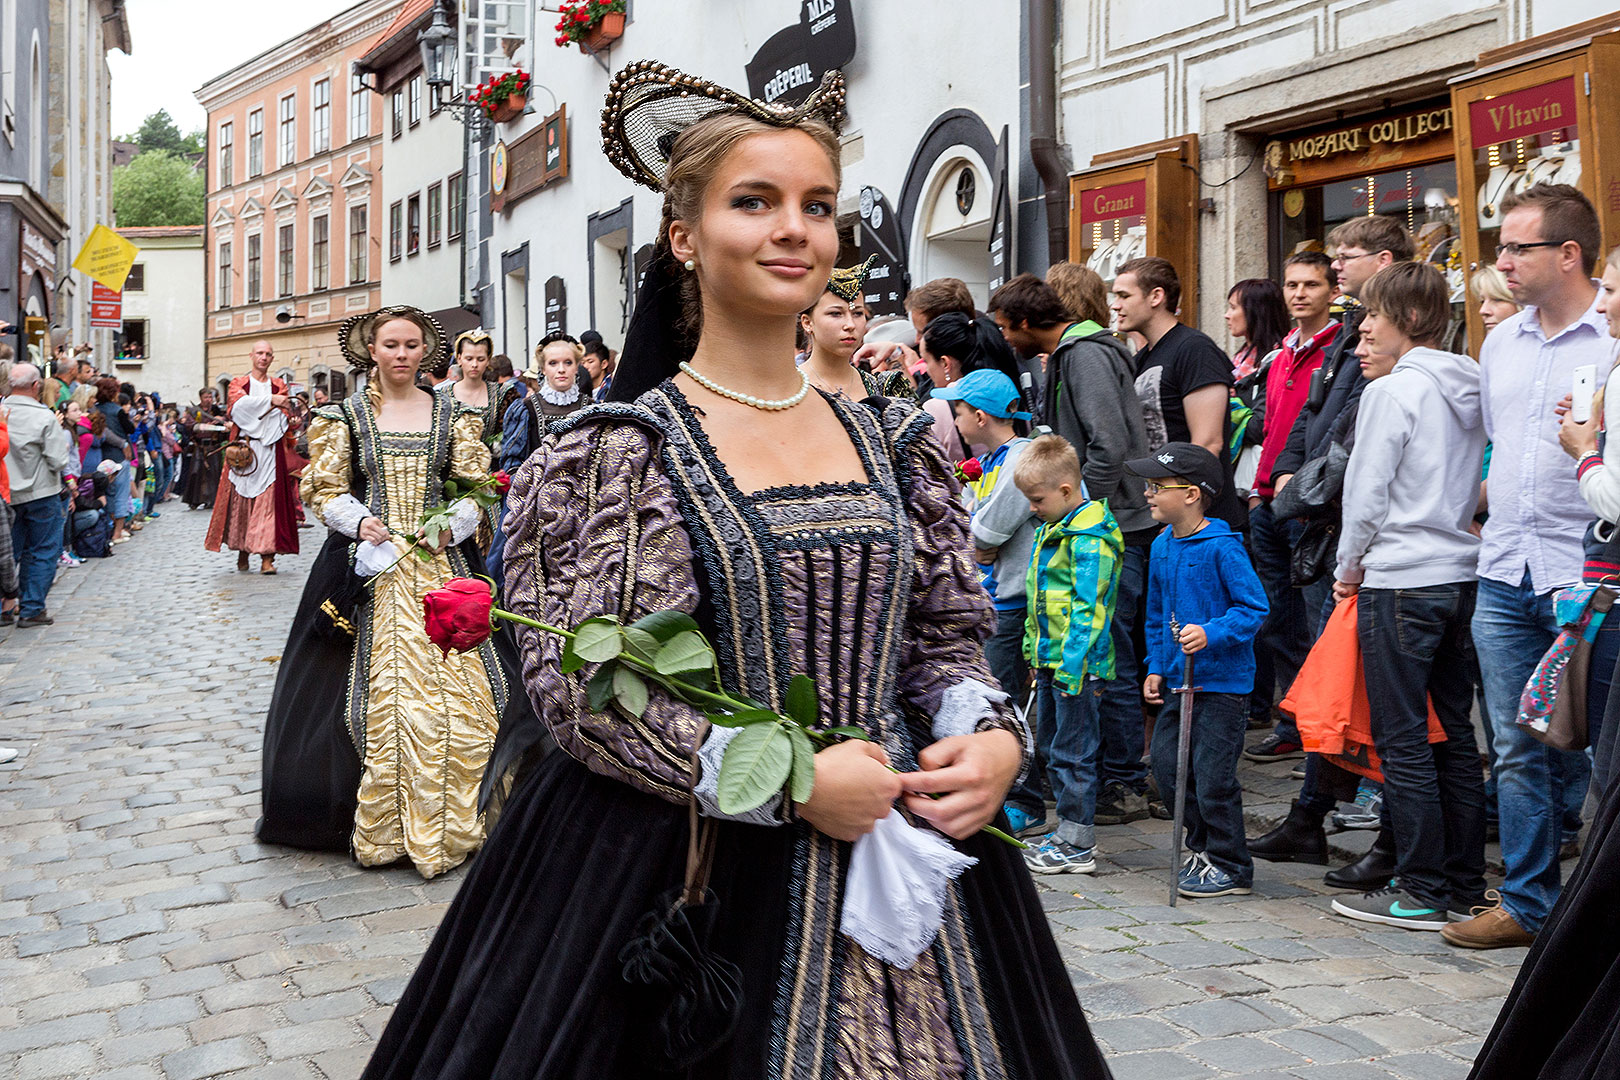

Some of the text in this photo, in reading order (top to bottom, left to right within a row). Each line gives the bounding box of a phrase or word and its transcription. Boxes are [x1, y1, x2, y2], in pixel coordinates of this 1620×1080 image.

[1488, 98, 1562, 133] Vltavín
[1289, 128, 1363, 162] MOZART
[1094, 195, 1134, 215] Granat
